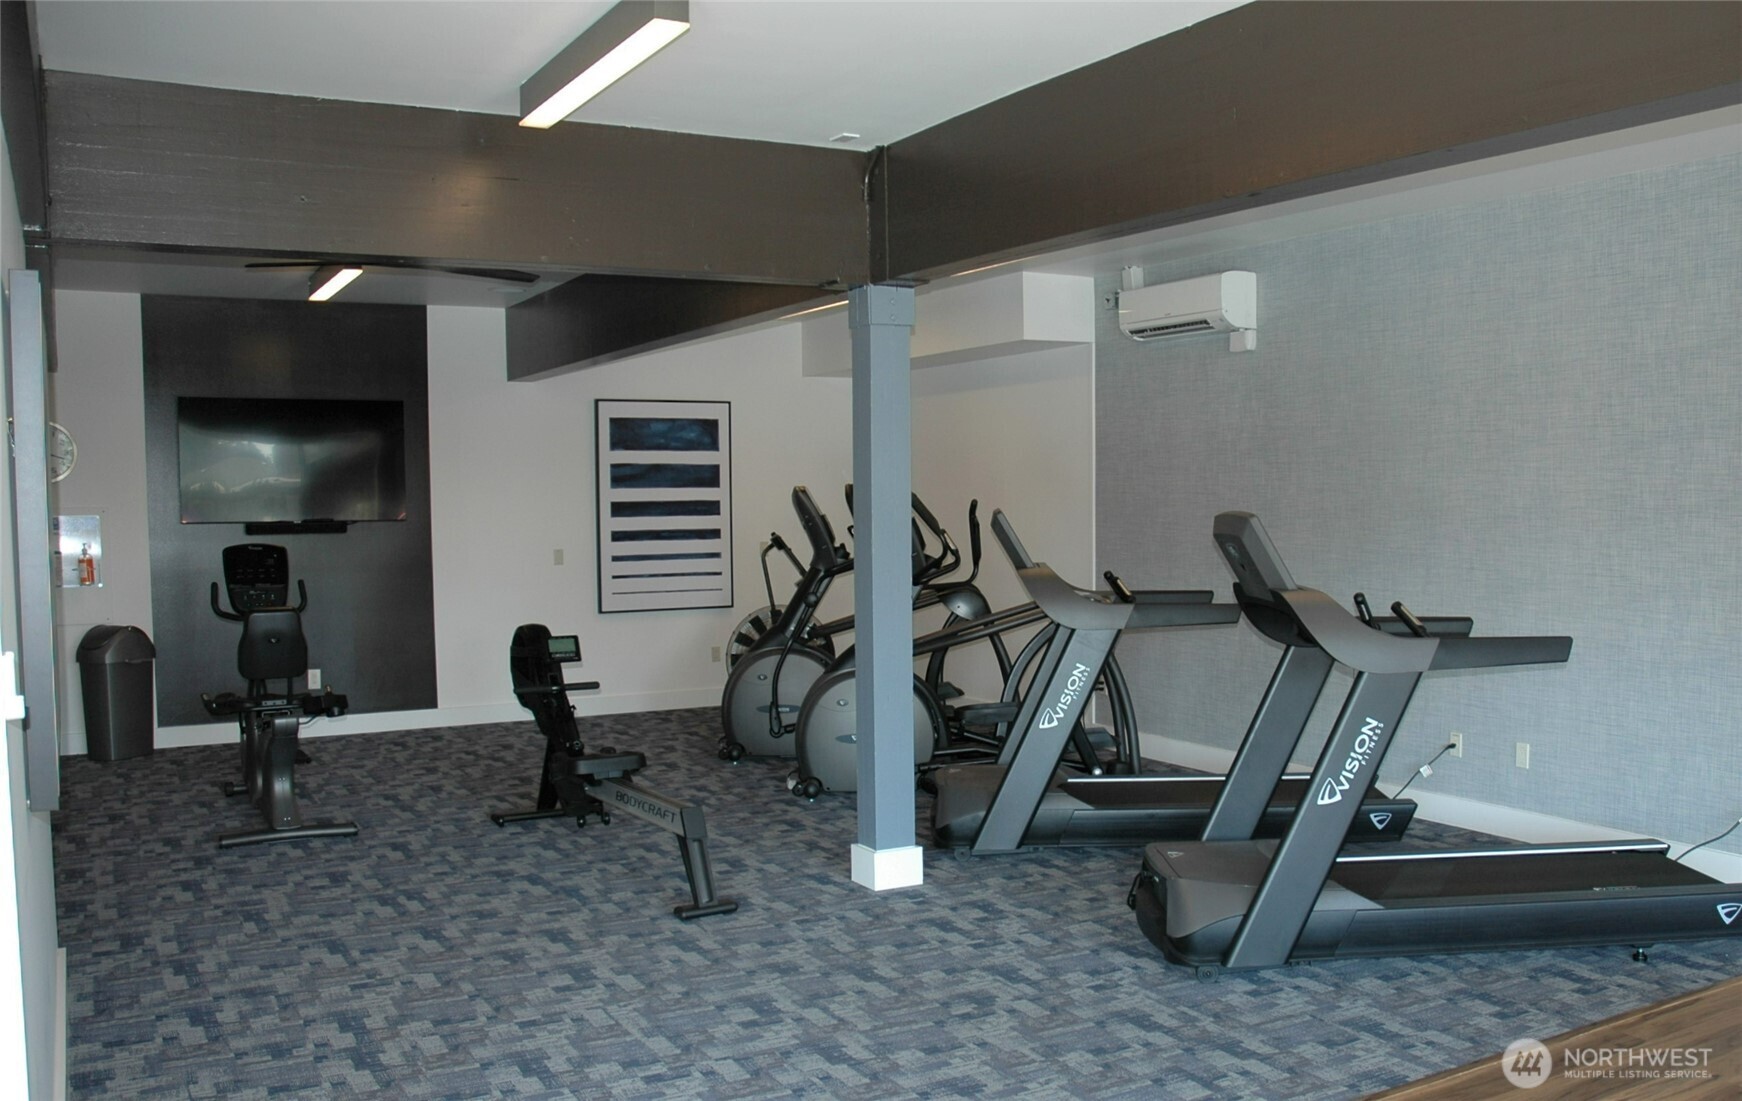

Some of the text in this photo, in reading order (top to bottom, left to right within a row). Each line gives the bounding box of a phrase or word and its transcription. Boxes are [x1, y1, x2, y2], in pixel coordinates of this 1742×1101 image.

[1055, 663, 1086, 718] VISION
[1337, 717, 1379, 790] VISION
[1361, 722, 1384, 766] FITNESS
[615, 790, 677, 824] BODYCRAFT
